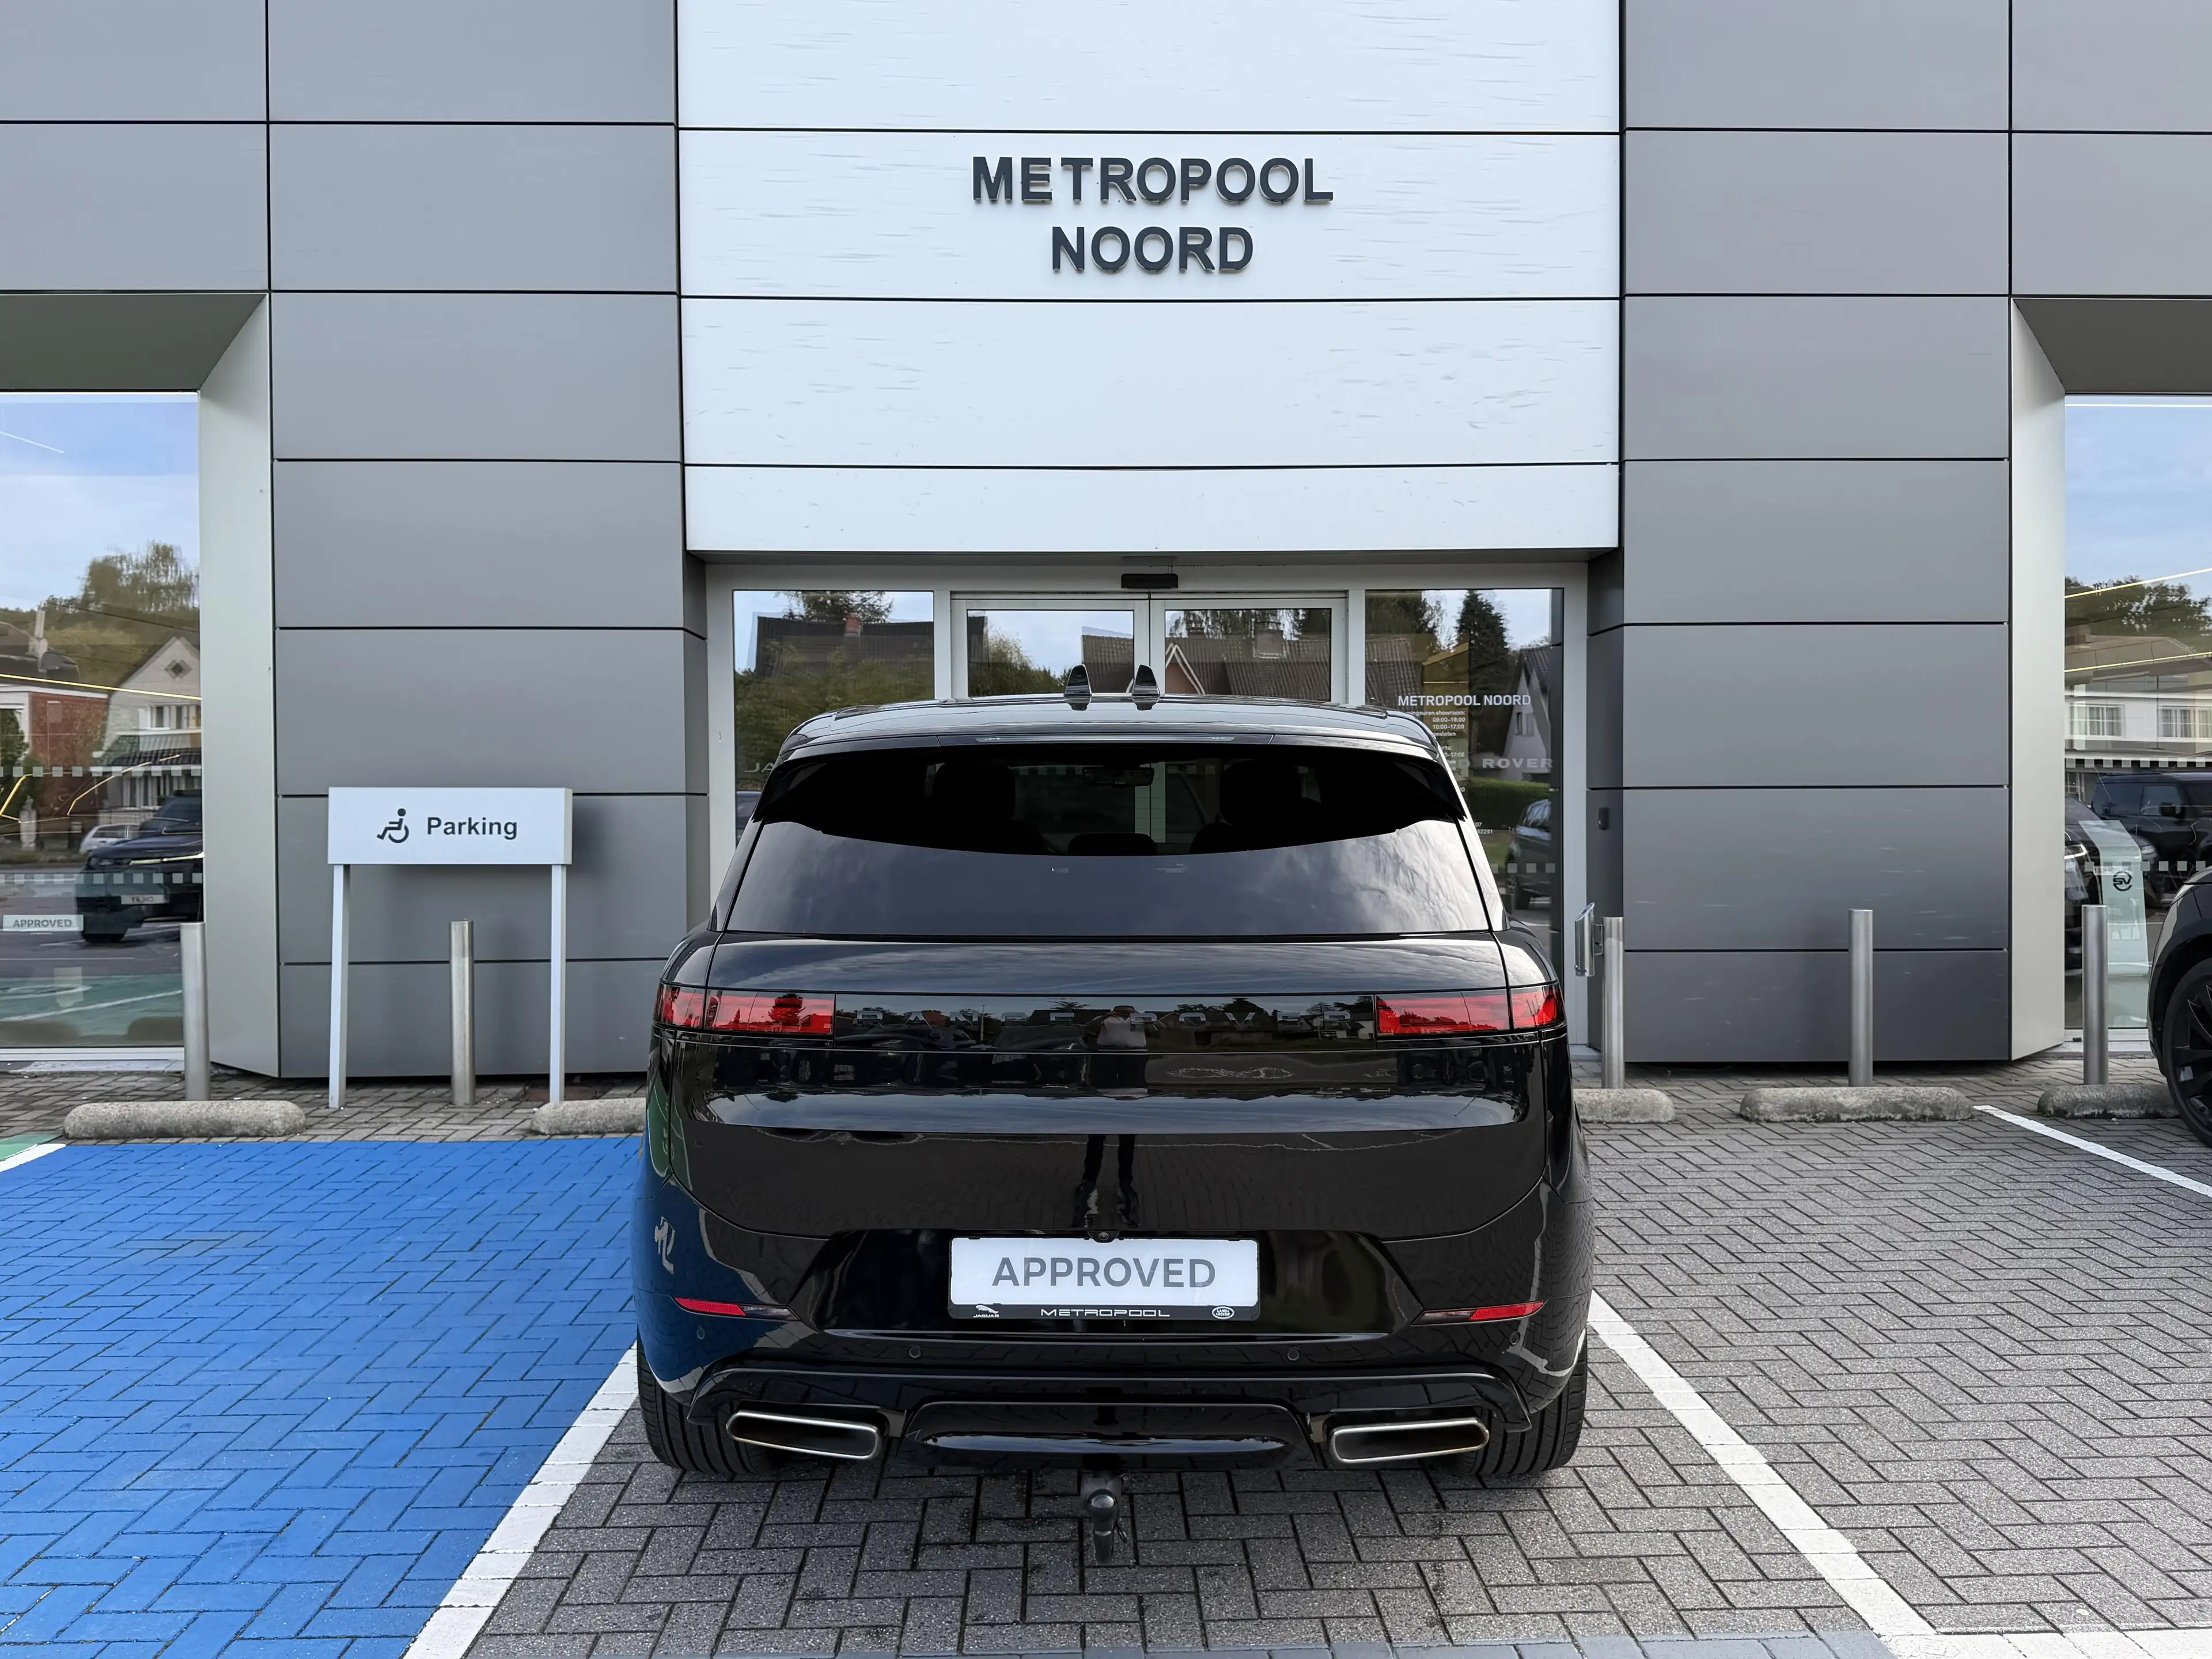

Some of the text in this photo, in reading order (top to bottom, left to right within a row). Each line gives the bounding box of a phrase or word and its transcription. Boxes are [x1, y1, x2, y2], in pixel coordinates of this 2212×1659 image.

[972, 156, 1334, 203] METROPOOL
[1052, 226, 1253, 272] NOORD
[1398, 694, 1531, 706] METROPOOL NOORD
[1482, 757, 1553, 769] ROVER
[427, 816, 518, 840] Parking
[13, 919, 73, 928] APPROVED
[991, 1257, 1215, 1288] APPROVED
[1040, 1309, 1171, 1318] METROPOOL
